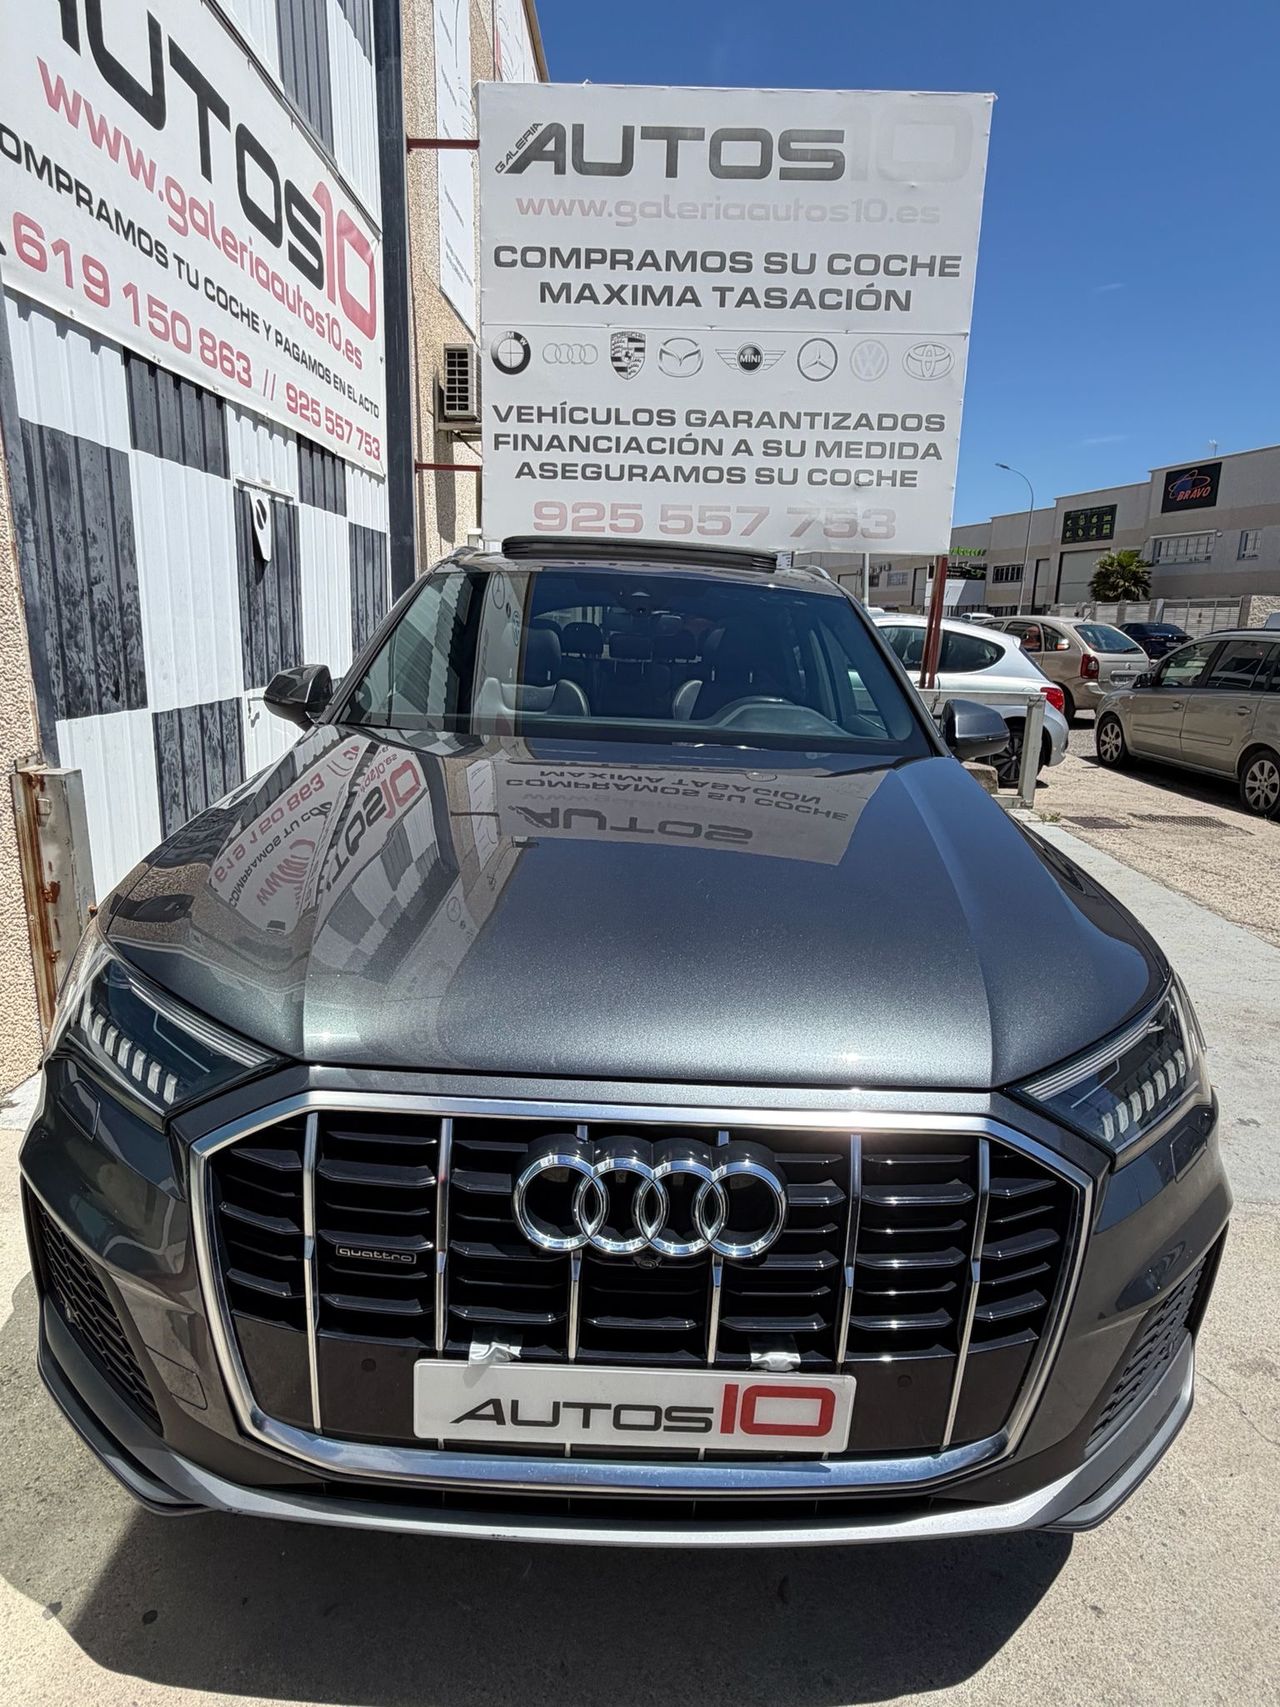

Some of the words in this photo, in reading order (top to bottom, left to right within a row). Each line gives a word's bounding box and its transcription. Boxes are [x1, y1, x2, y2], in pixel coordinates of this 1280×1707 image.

[494, 122, 544, 175] GALERIA
[36, 55, 363, 370] www.galeriaautos10.es
[515, 194, 940, 228] www.galeriaautos10.es
[493, 245, 754, 274] COMPRAMOS
[763, 251, 816, 276] SU
[826, 252, 963, 278] COCHE
[539, 281, 705, 308] MAXIMA
[711, 281, 912, 312] TASACIÓN
[13, 211, 111, 308] 619
[122, 275, 193, 356] 150
[198, 327, 253, 389] 863
[285, 382, 322, 428] 925
[324, 405, 353, 445] 557
[356, 427, 381, 462] 753
[172, 252, 200, 291] TU
[204, 276, 260, 334] COCHE
[262, 318, 273, 342] Y
[275, 328, 332, 385] PAGAMOS
[333, 375, 346, 396] EN
[347, 385, 358, 404] EL
[358, 393, 380, 419] ACTO
[739, 353, 762, 363] MINI
[492, 401, 676, 427] VEHÍCULOS
[684, 409, 947, 432] GARANTIZADOS
[493, 433, 724, 457] FINANCIACIÓN
[732, 438, 754, 458] A
[761, 438, 806, 459] SU
[815, 440, 943, 460] MEDIDA
[515, 461, 745, 485] ASEGURAMOS
[755, 466, 800, 486] SU
[807, 467, 918, 488] COCHE
[1176, 486, 1211, 502] BRAVO
[532, 500, 644, 534] 925
[658, 503, 771, 537] 557
[786, 505, 897, 540] 753
[339, 1248, 412, 1262] quattro
[449, 1383, 836, 1438] AUTOS10
